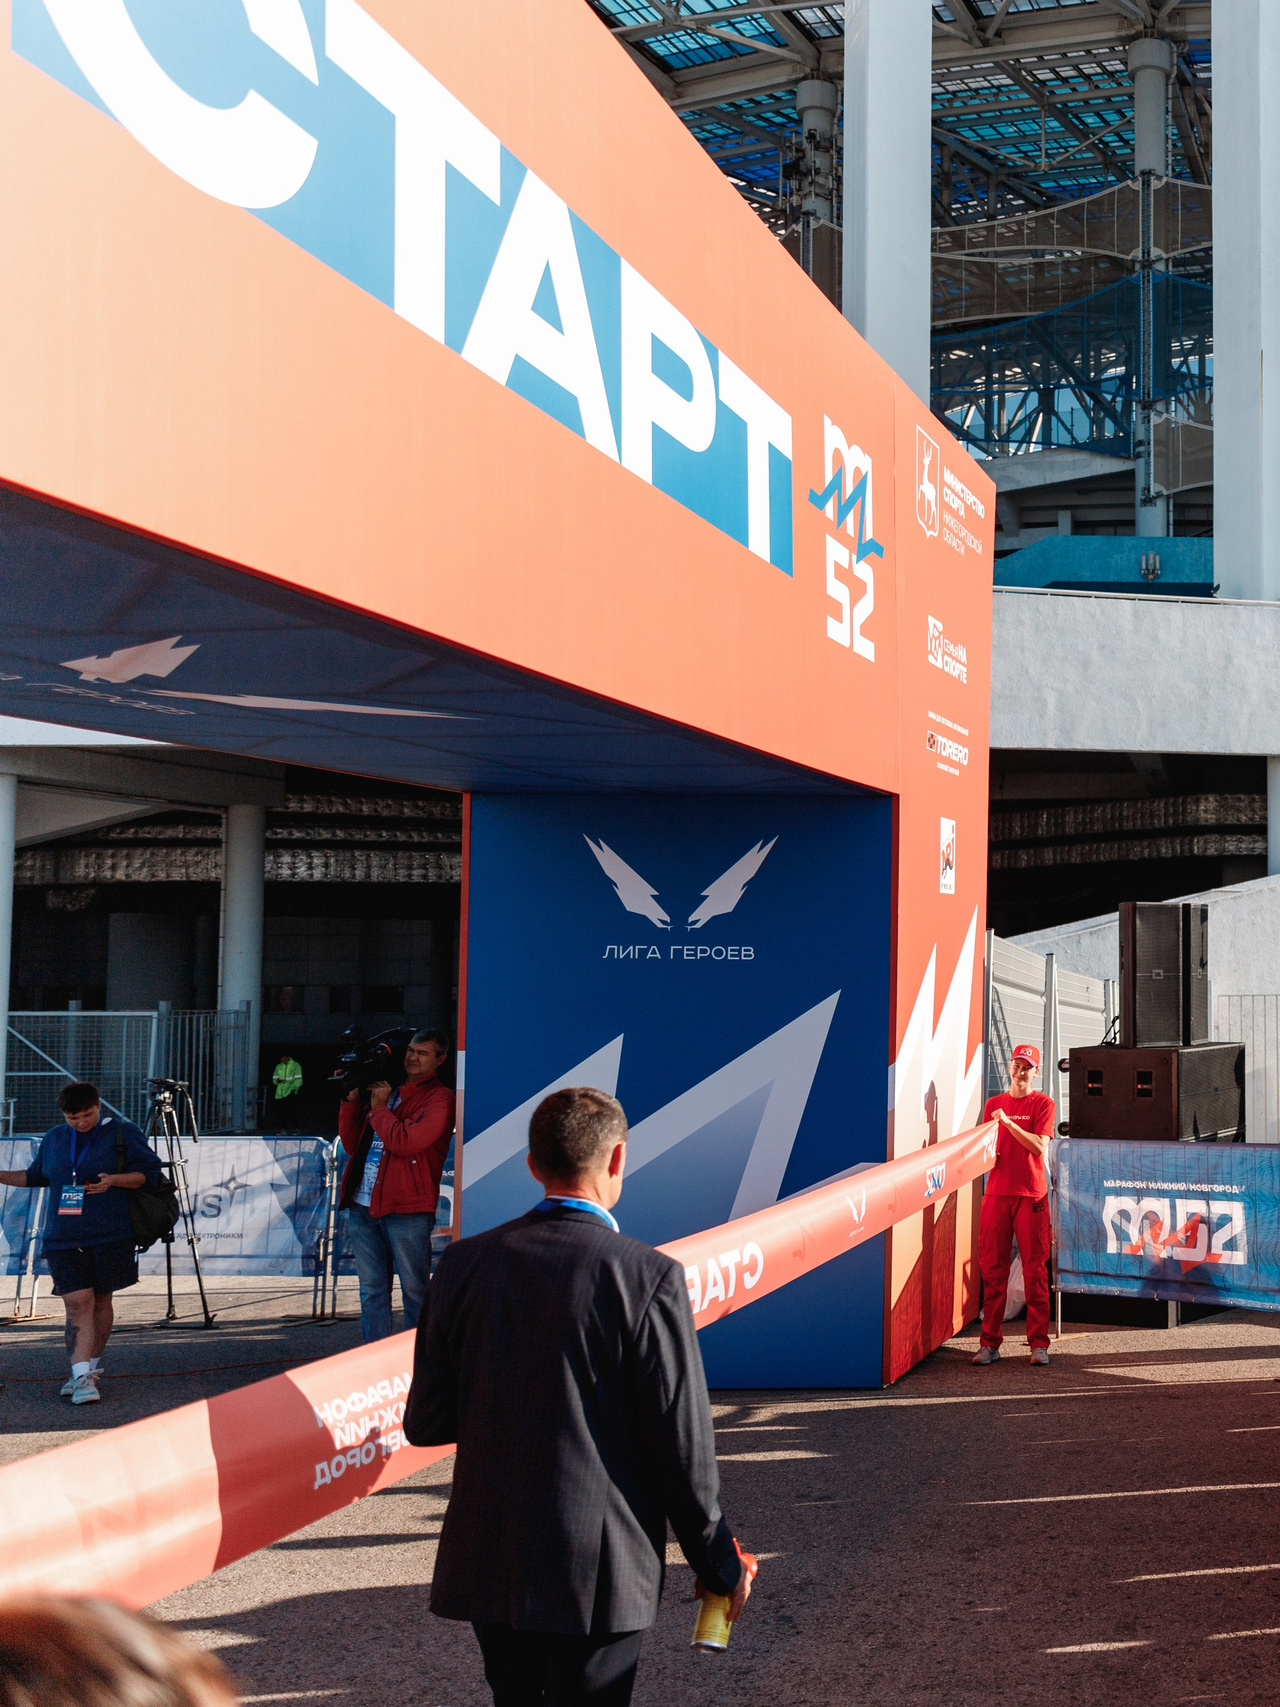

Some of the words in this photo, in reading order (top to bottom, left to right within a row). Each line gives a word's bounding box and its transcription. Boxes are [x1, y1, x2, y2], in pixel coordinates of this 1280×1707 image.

[42, 0, 794, 565] СТАРТ
[943, 465, 985, 519] МИНИСТЕРСТВО
[943, 486, 965, 519] СПОРТА
[943, 509, 983, 556] НИЖЕГОРОДСКОЙ
[943, 527, 965, 557] ОБЛАСТИ
[943, 654, 967, 684] СПОРТЕ
[937, 734, 969, 766] TORERO
[602, 945, 661, 960] ЛИГА
[670, 945, 755, 961] ГЕРОЕВ
[1103, 1179, 1147, 1189] МАРАФОН
[1148, 1180, 1187, 1191] НИЖНИЙ
[1189, 1183, 1240, 1194] НОВГОРОД
